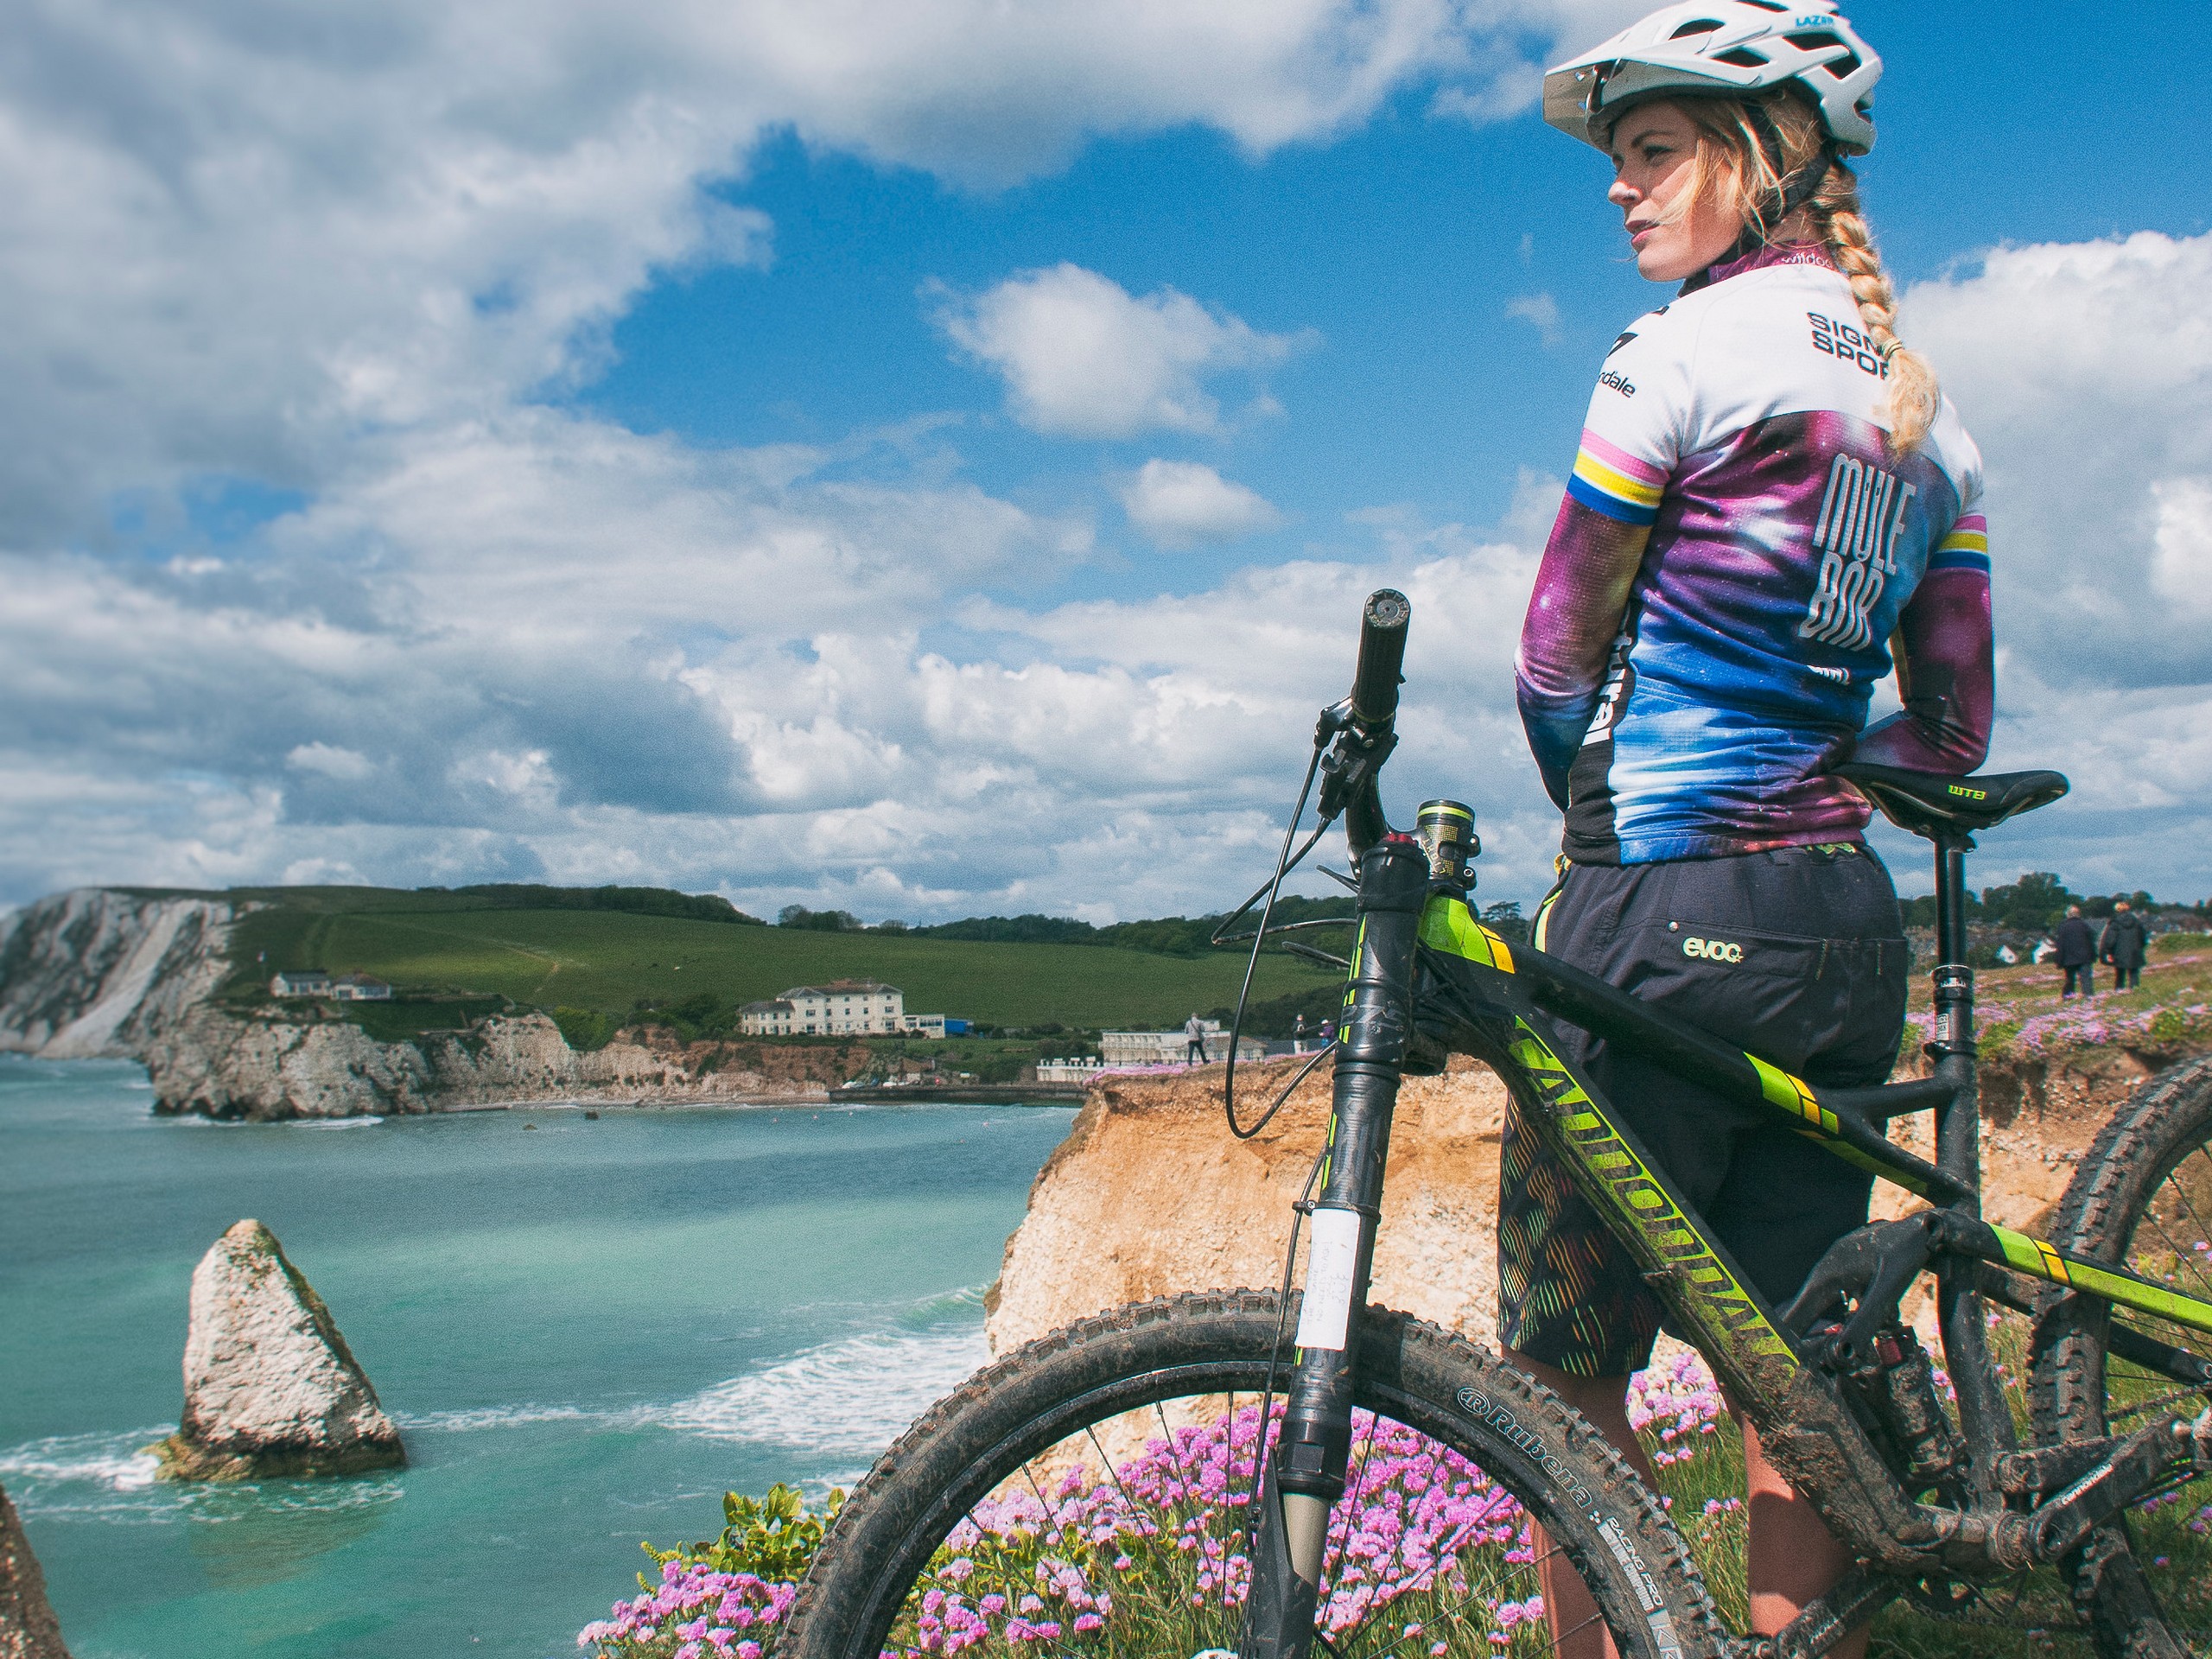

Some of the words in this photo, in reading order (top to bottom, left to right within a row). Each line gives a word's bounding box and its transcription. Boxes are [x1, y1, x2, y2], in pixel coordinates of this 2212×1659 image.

[1797, 549, 1885, 652] BAR
[1948, 785, 1987, 801] WTB
[1682, 937, 1745, 963] evoc
[1485, 1405, 1592, 1509] Rubena
[1606, 1516, 1646, 1572] RACING
[1641, 1572, 1664, 1607] PRO
